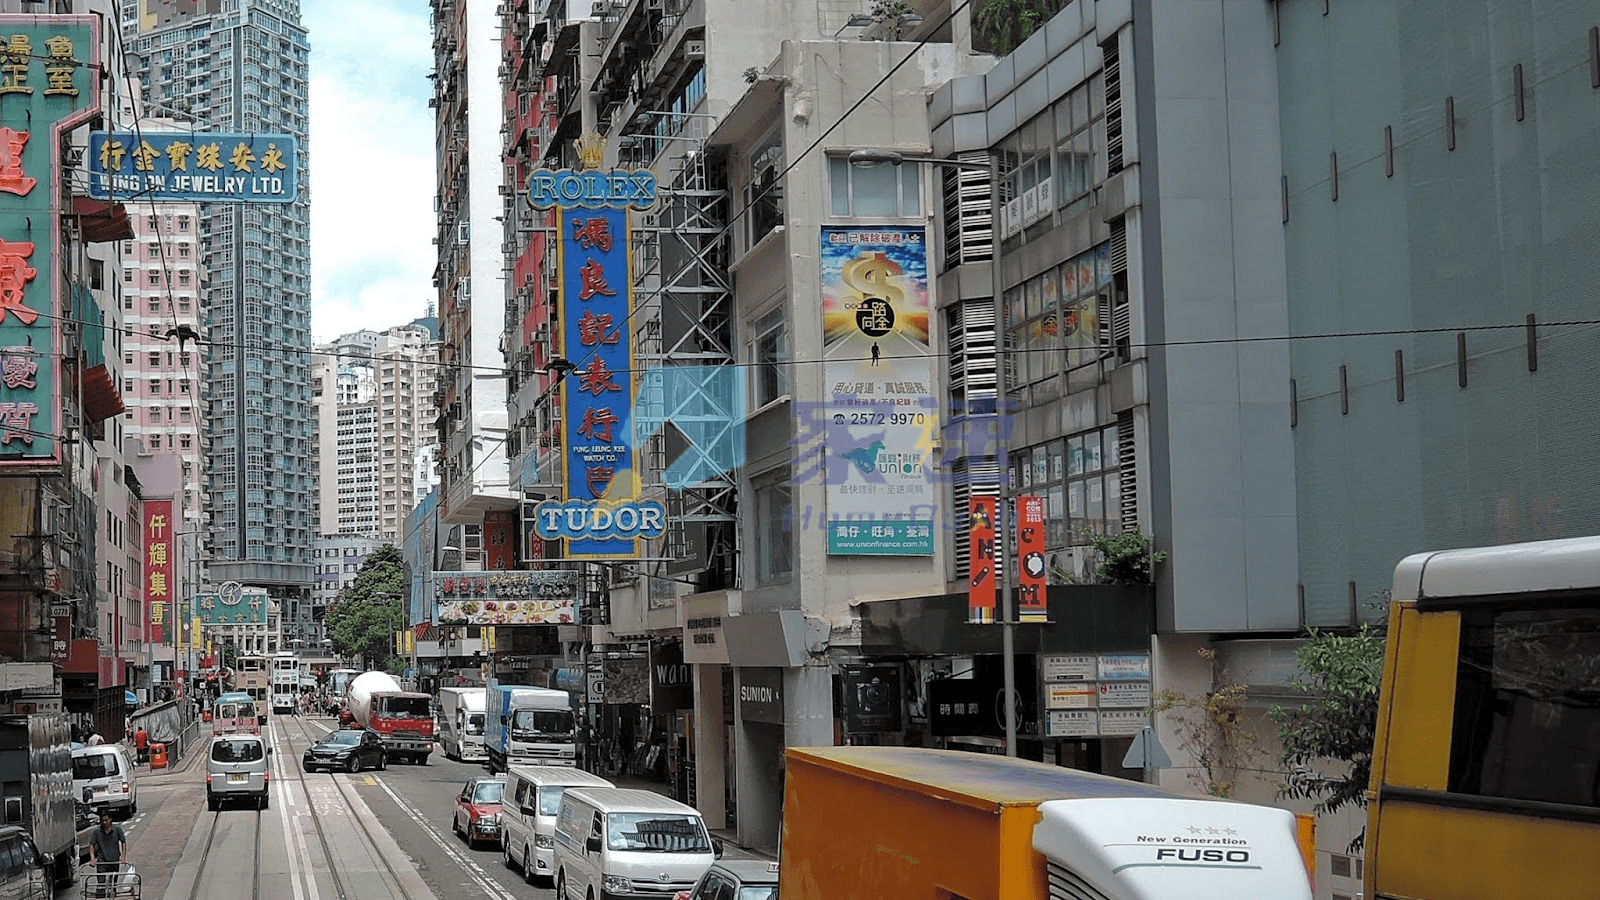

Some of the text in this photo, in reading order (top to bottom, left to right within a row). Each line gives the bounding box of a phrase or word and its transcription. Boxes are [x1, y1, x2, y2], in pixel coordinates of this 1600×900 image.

[100, 174, 286, 195] WING ON JEWELRY LTD.
[534, 176, 655, 200] ROLEX
[851, 413, 925, 425] 2572 9970
[879, 457, 922, 473] union
[541, 507, 662, 531] TUDOR
[836, 540, 929, 548] www.unionfinance.com.hk
[741, 686, 772, 702] SUNION
[1137, 835, 1247, 845] New Generation
[1156, 848, 1250, 863] FUSO
